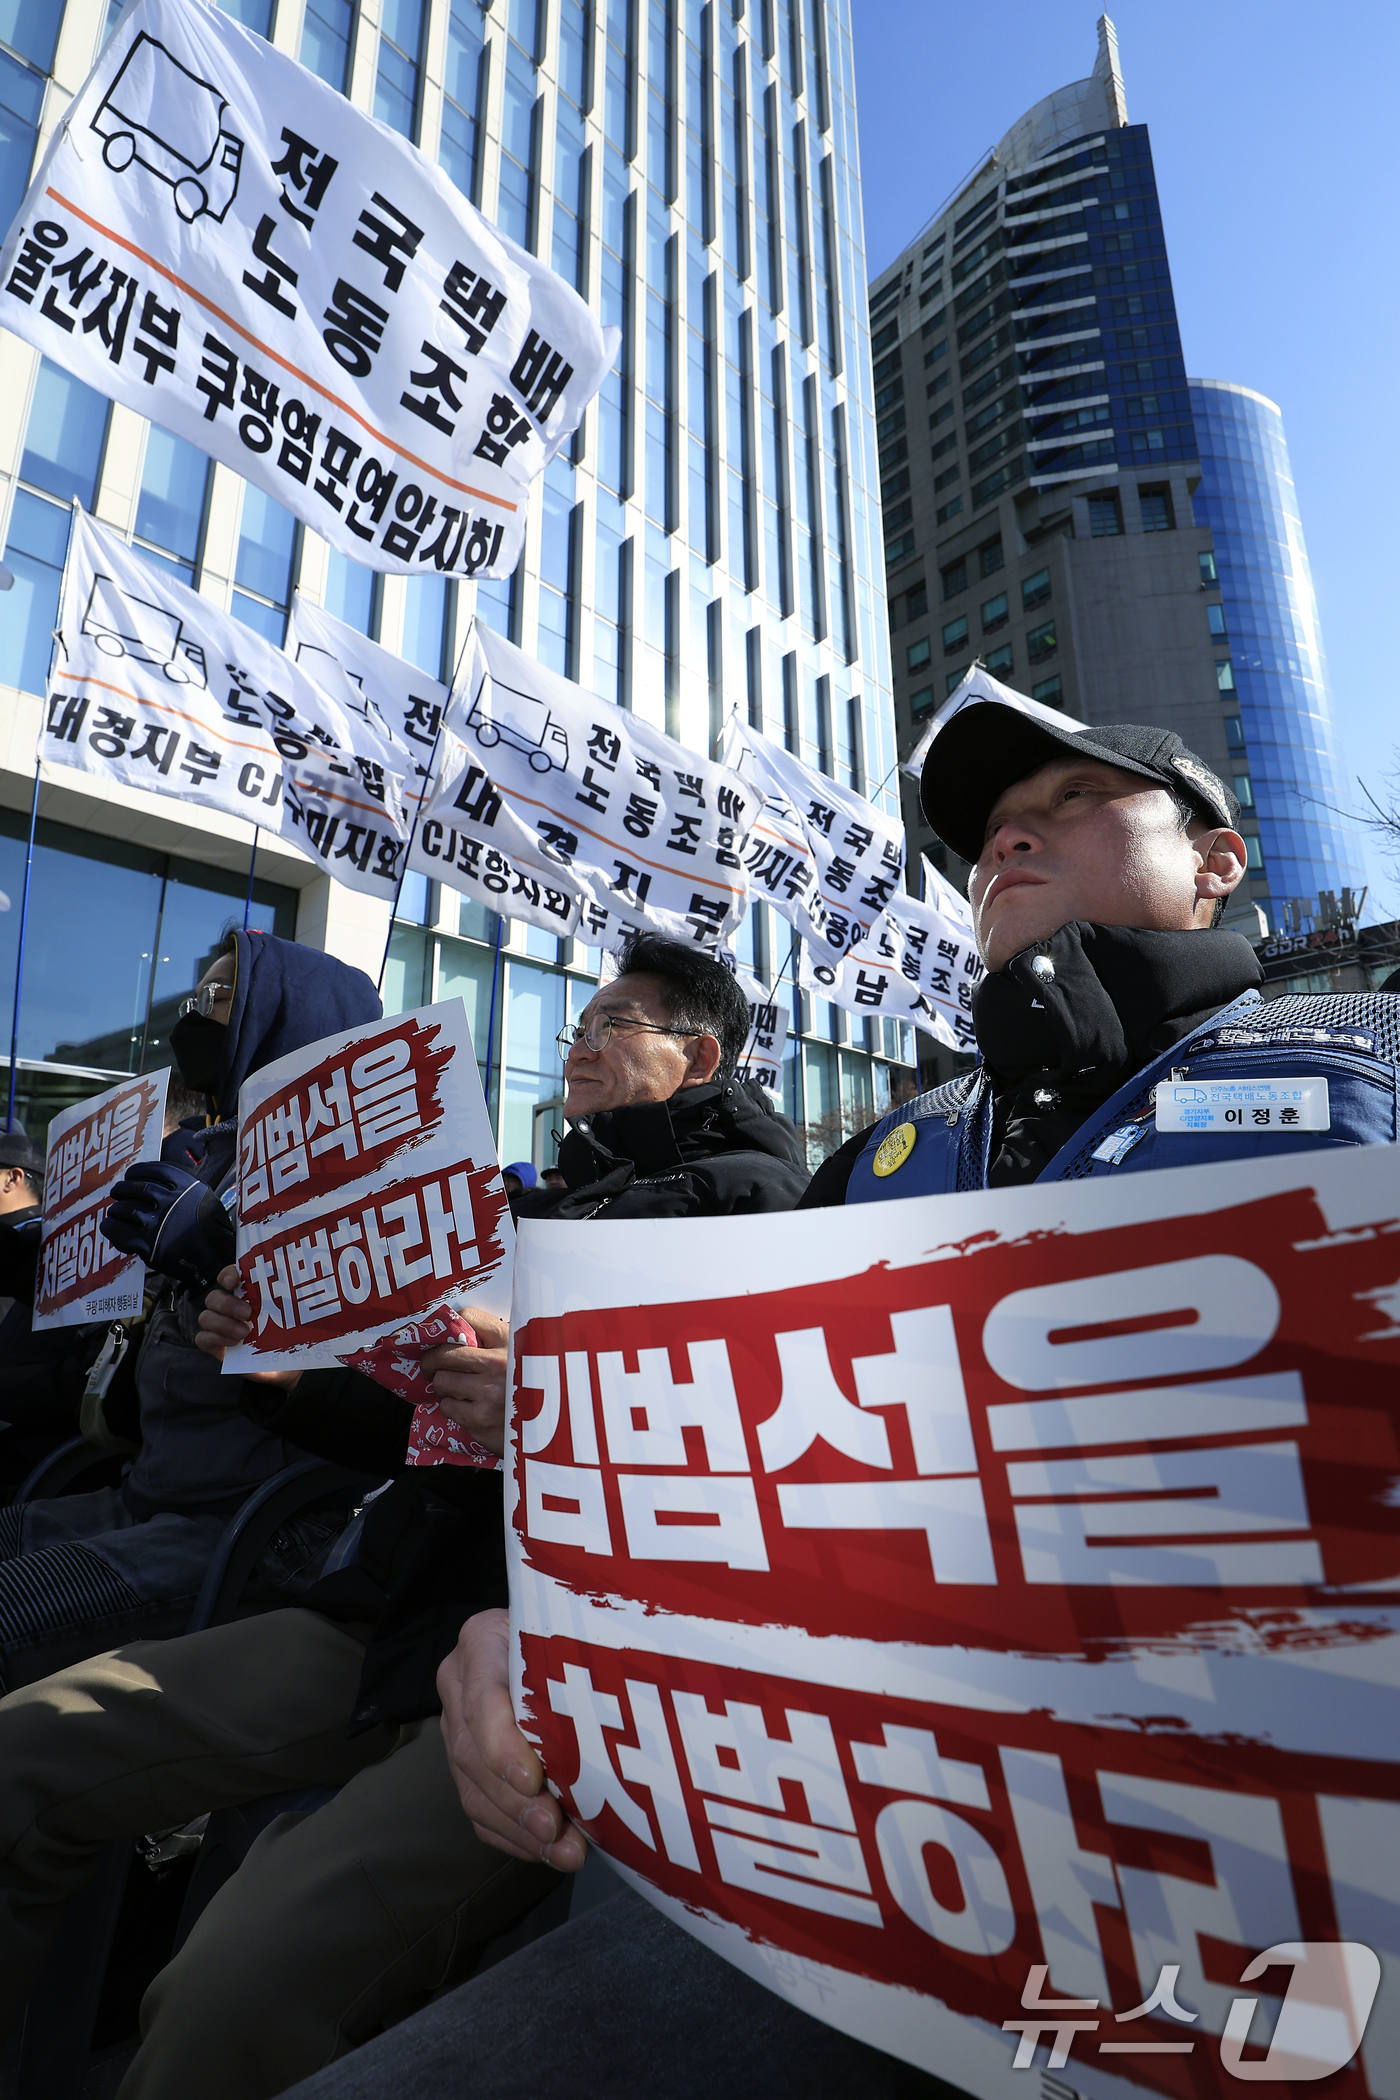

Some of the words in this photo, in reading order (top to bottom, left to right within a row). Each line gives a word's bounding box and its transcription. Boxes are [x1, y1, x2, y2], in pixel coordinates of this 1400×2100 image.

[241, 213, 532, 468] 노동조합
[271, 126, 574, 425] 전국택배
[46, 693, 224, 785] 대경지부
[45, 1091, 142, 1207] 김범석을
[241, 1037, 423, 1205] 김범석을
[1211, 1091, 1303, 1102] 전국택배노동조합
[1225, 1108, 1300, 1125] 이정훈
[249, 1170, 478, 1338] 처벌하라!
[521, 1253, 1327, 1588] 김범석을
